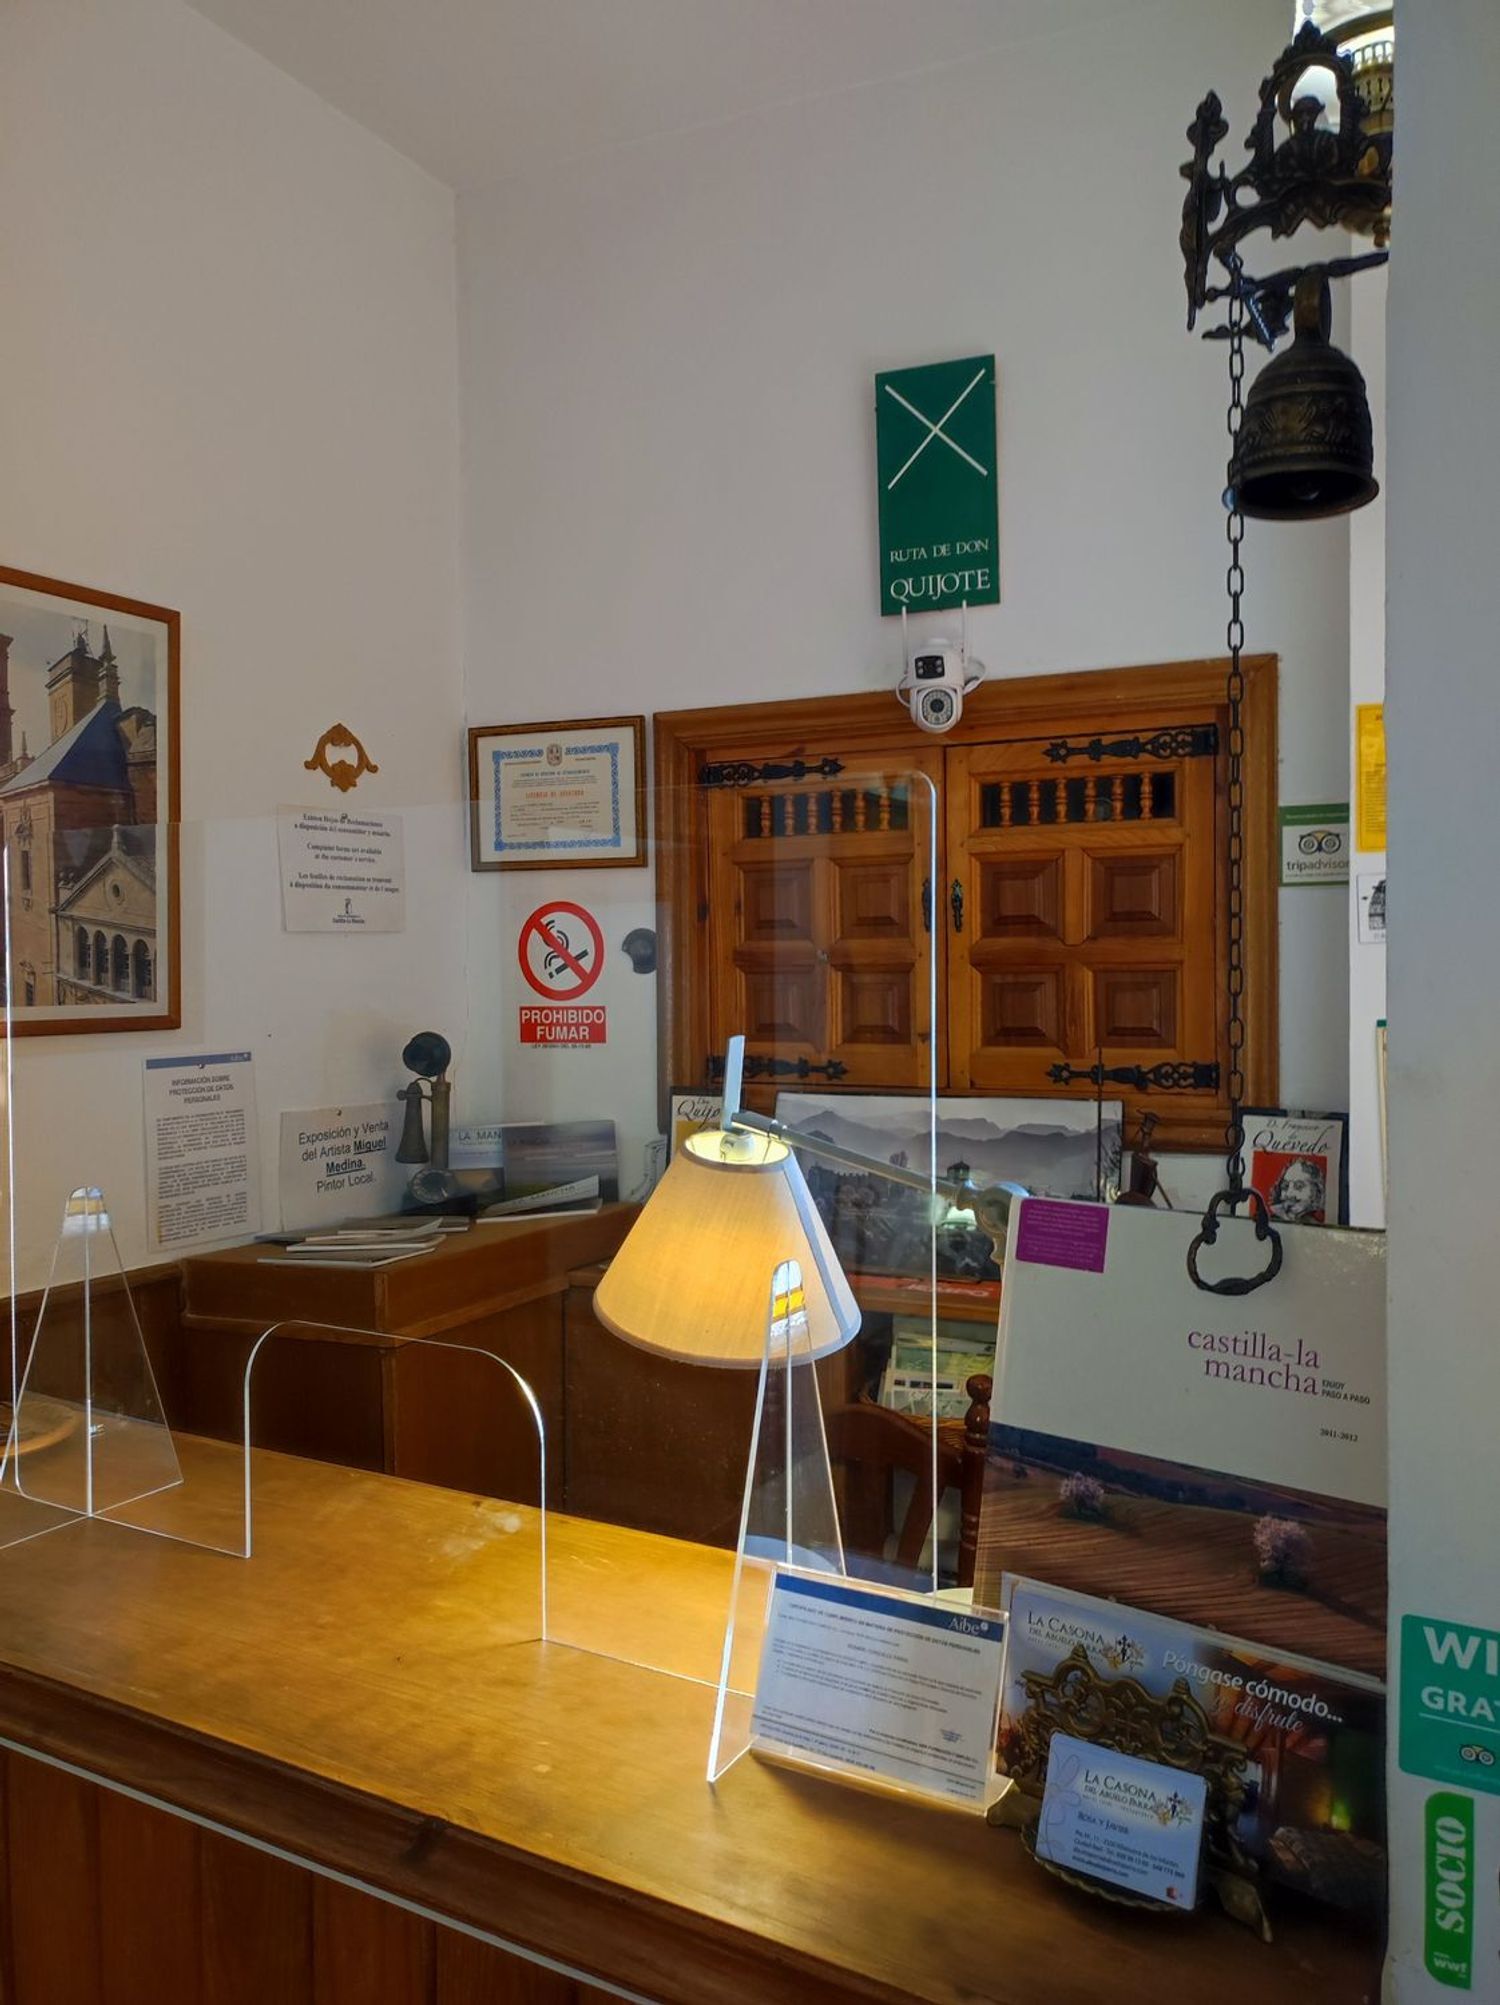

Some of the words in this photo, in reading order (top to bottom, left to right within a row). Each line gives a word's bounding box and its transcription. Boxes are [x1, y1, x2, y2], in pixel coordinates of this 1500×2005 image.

[890, 547, 927, 562] RUTA
[933, 544, 951, 557] DE
[956, 539, 989, 554] DON
[890, 568, 990, 603] QUIJOTE
[521, 1009, 605, 1024] PROHIBIDO
[536, 1026, 590, 1040] FUMAR
[299, 1126, 351, 1145] Exposición
[353, 1126, 360, 1138] y
[361, 1120, 389, 1134] Venta
[458, 1131, 471, 1141] LA
[1252, 1125, 1334, 1156] Quevedo
[302, 1147, 317, 1162] del
[320, 1144, 351, 1159] Artista
[353, 1135, 387, 1153] Miguel
[316, 1178, 345, 1193] Pintor
[1187, 1330, 1320, 1369] castilla-la
[1205, 1358, 1319, 1396] mancha
[1321, 1388, 1342, 1400] PASO
[1342, 1393, 1349, 1401] A
[1349, 1393, 1371, 1405] PASO
[1320, 1428, 1358, 1442] 2011-2012
[948, 1616, 981, 1635] Aibe
[1163, 1650, 1243, 1692] Póngase
[1245, 1678, 1343, 1723] cómodo...
[1233, 1694, 1303, 1733] disfrute
[1084, 1769, 1100, 1785] LA
[1103, 1775, 1155, 1800] CASONA
[1435, 1816, 1466, 1934] SOCIO
